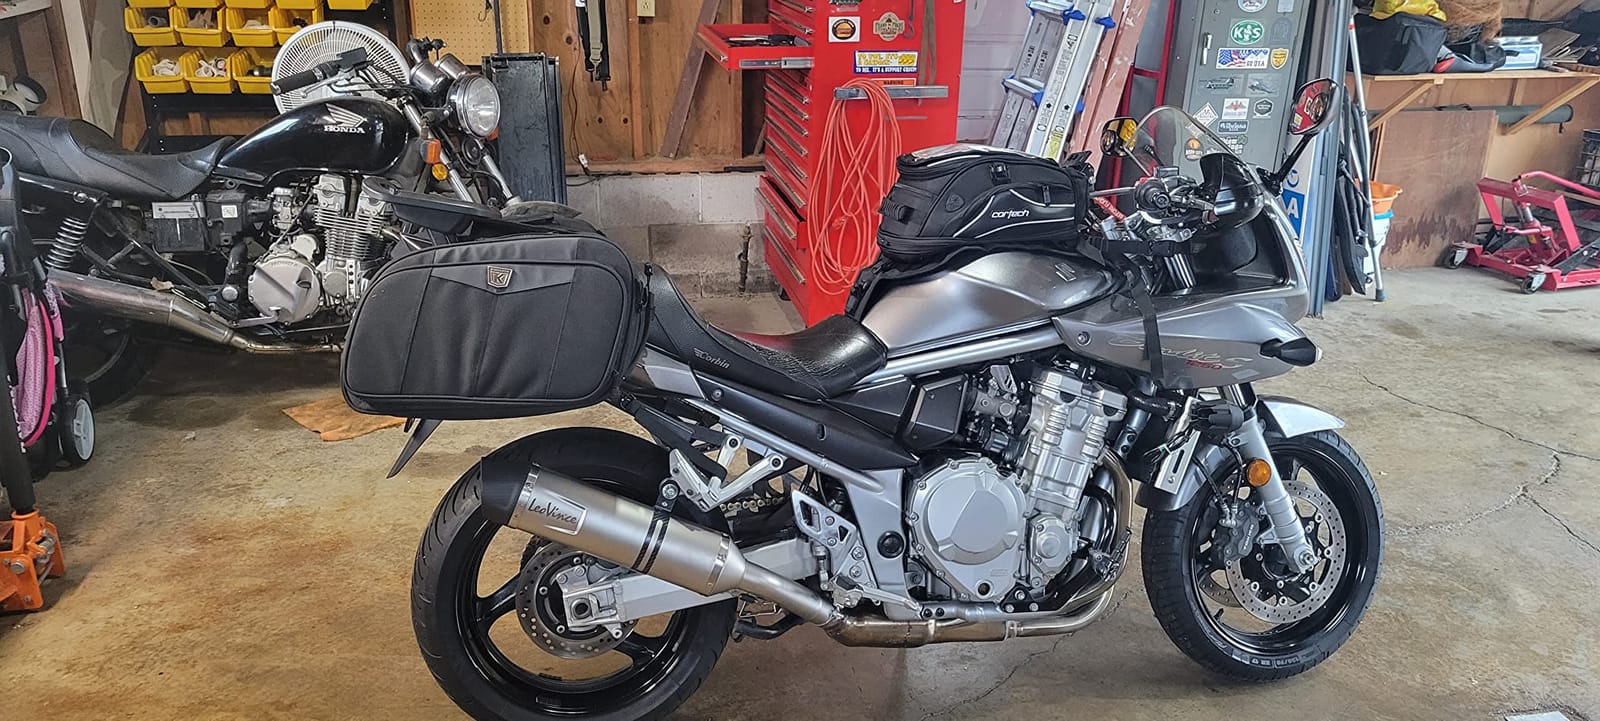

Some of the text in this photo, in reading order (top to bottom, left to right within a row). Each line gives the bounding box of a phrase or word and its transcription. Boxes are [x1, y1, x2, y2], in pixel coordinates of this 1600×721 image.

[323, 125, 366, 134] HONDA
[991, 209, 1030, 219] cortech
[699, 350, 731, 369] Corbin
[528, 497, 577, 524] LeoVince
